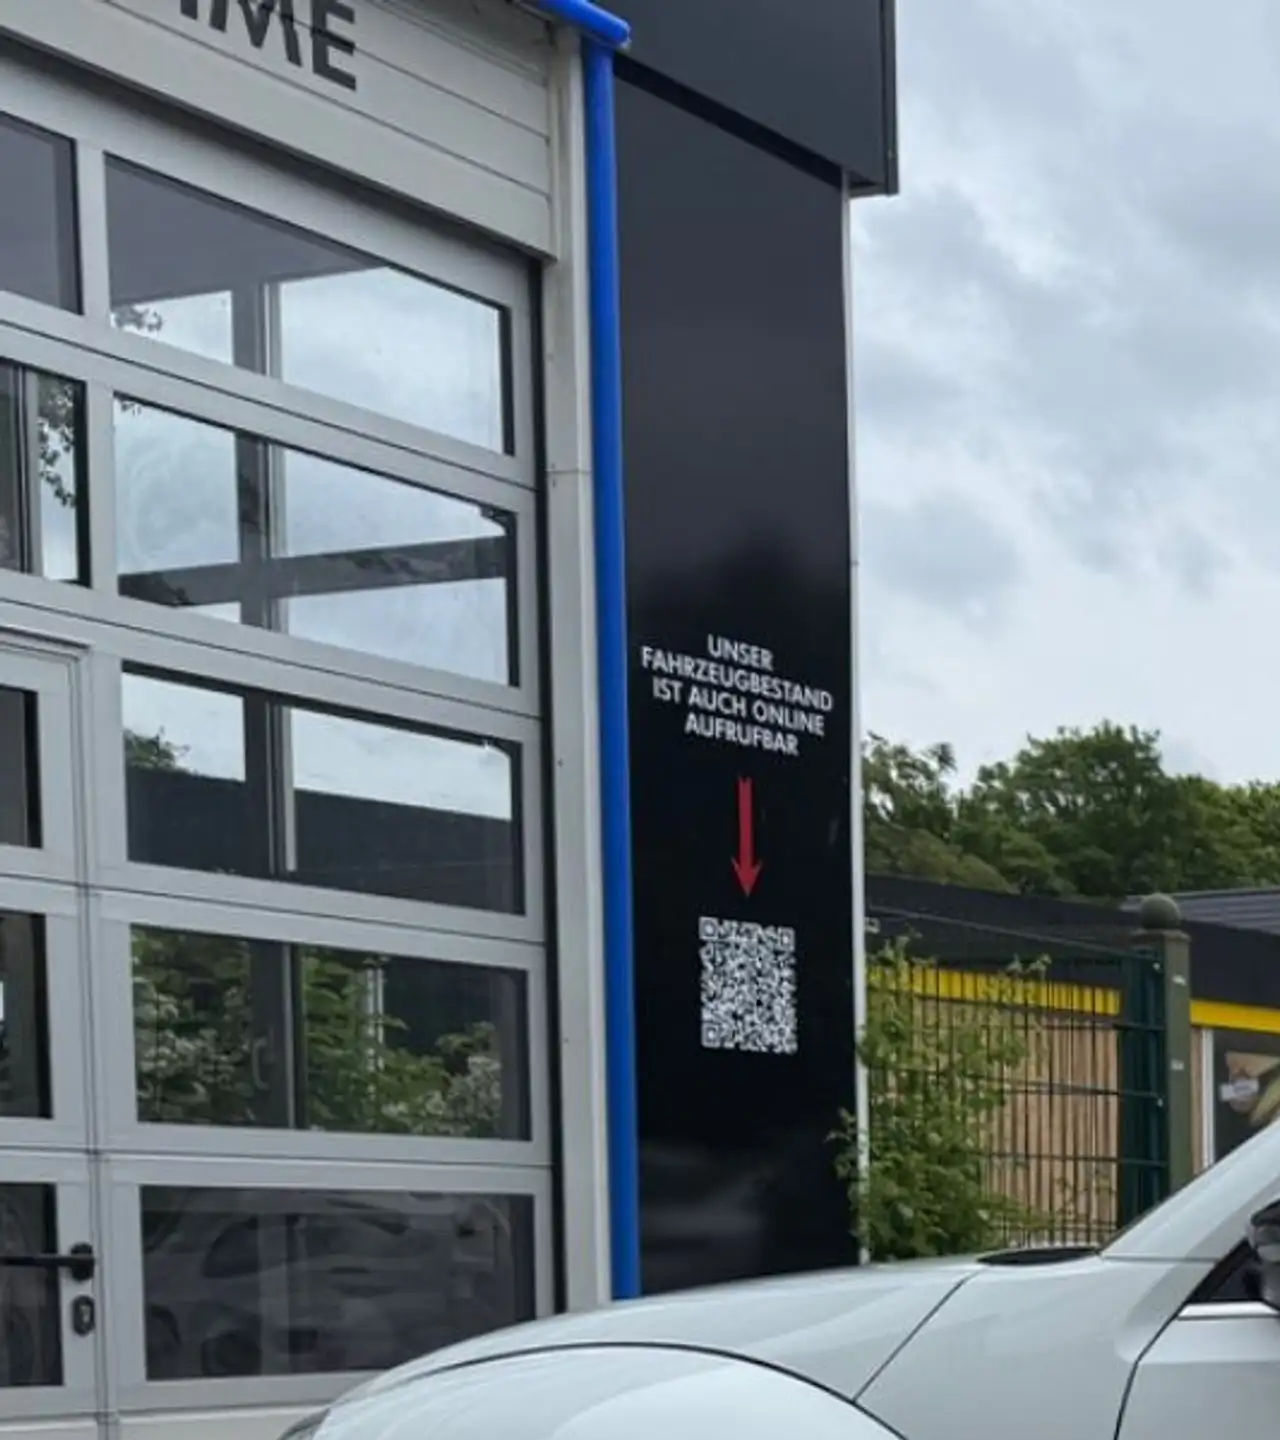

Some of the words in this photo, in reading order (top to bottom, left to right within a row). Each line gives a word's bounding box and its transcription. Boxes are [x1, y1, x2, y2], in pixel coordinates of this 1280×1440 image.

[641, 645, 834, 712] FAHRZEUGBESTAND
[707, 633, 774, 672] UNSER
[652, 675, 683, 704] IST
[688, 685, 748, 718] AUCH
[752, 700, 826, 737] ONLINE
[684, 711, 800, 757] AUFRUFBAR
